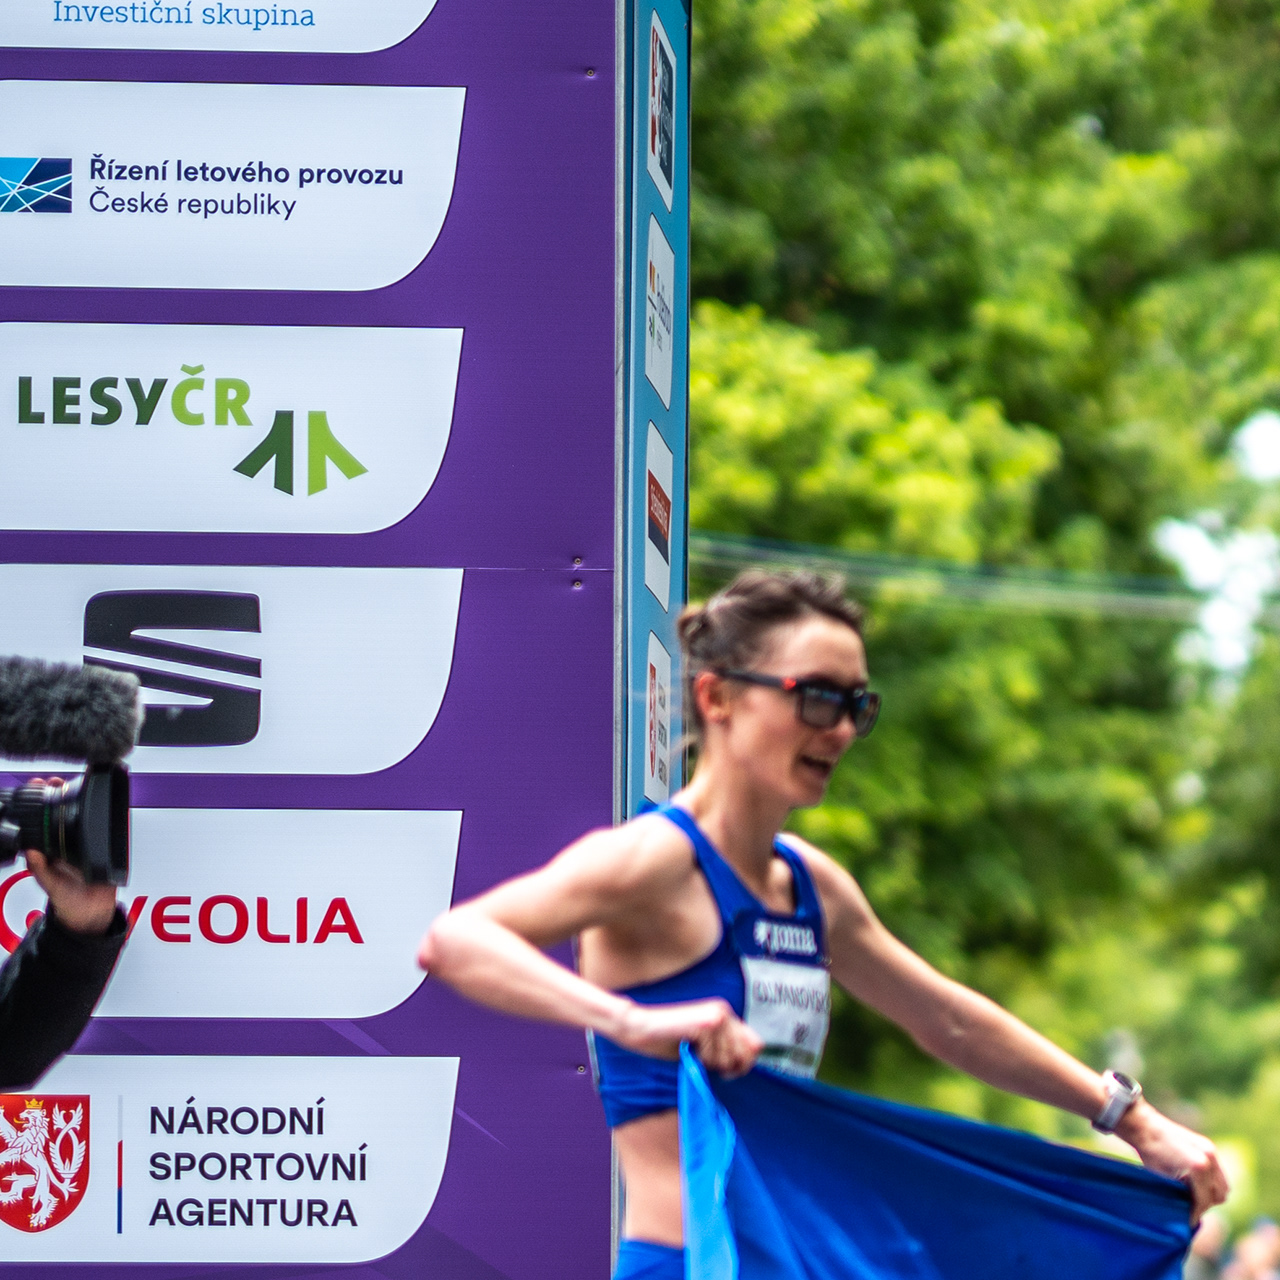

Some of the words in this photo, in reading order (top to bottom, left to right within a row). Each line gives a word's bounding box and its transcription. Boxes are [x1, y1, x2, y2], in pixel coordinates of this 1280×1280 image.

[53, 0, 193, 25] Investiční
[202, 3, 316, 31] skupina
[89, 153, 169, 181] Řízení
[176, 159, 290, 184] letového
[299, 167, 404, 188] provozu
[89, 186, 169, 214] České
[177, 189, 297, 220] republiky
[150, 1095, 326, 1135] NÁRODNÍ
[149, 1142, 368, 1181] SPORTOVNÍ
[149, 1198, 358, 1227] AGENTURA
